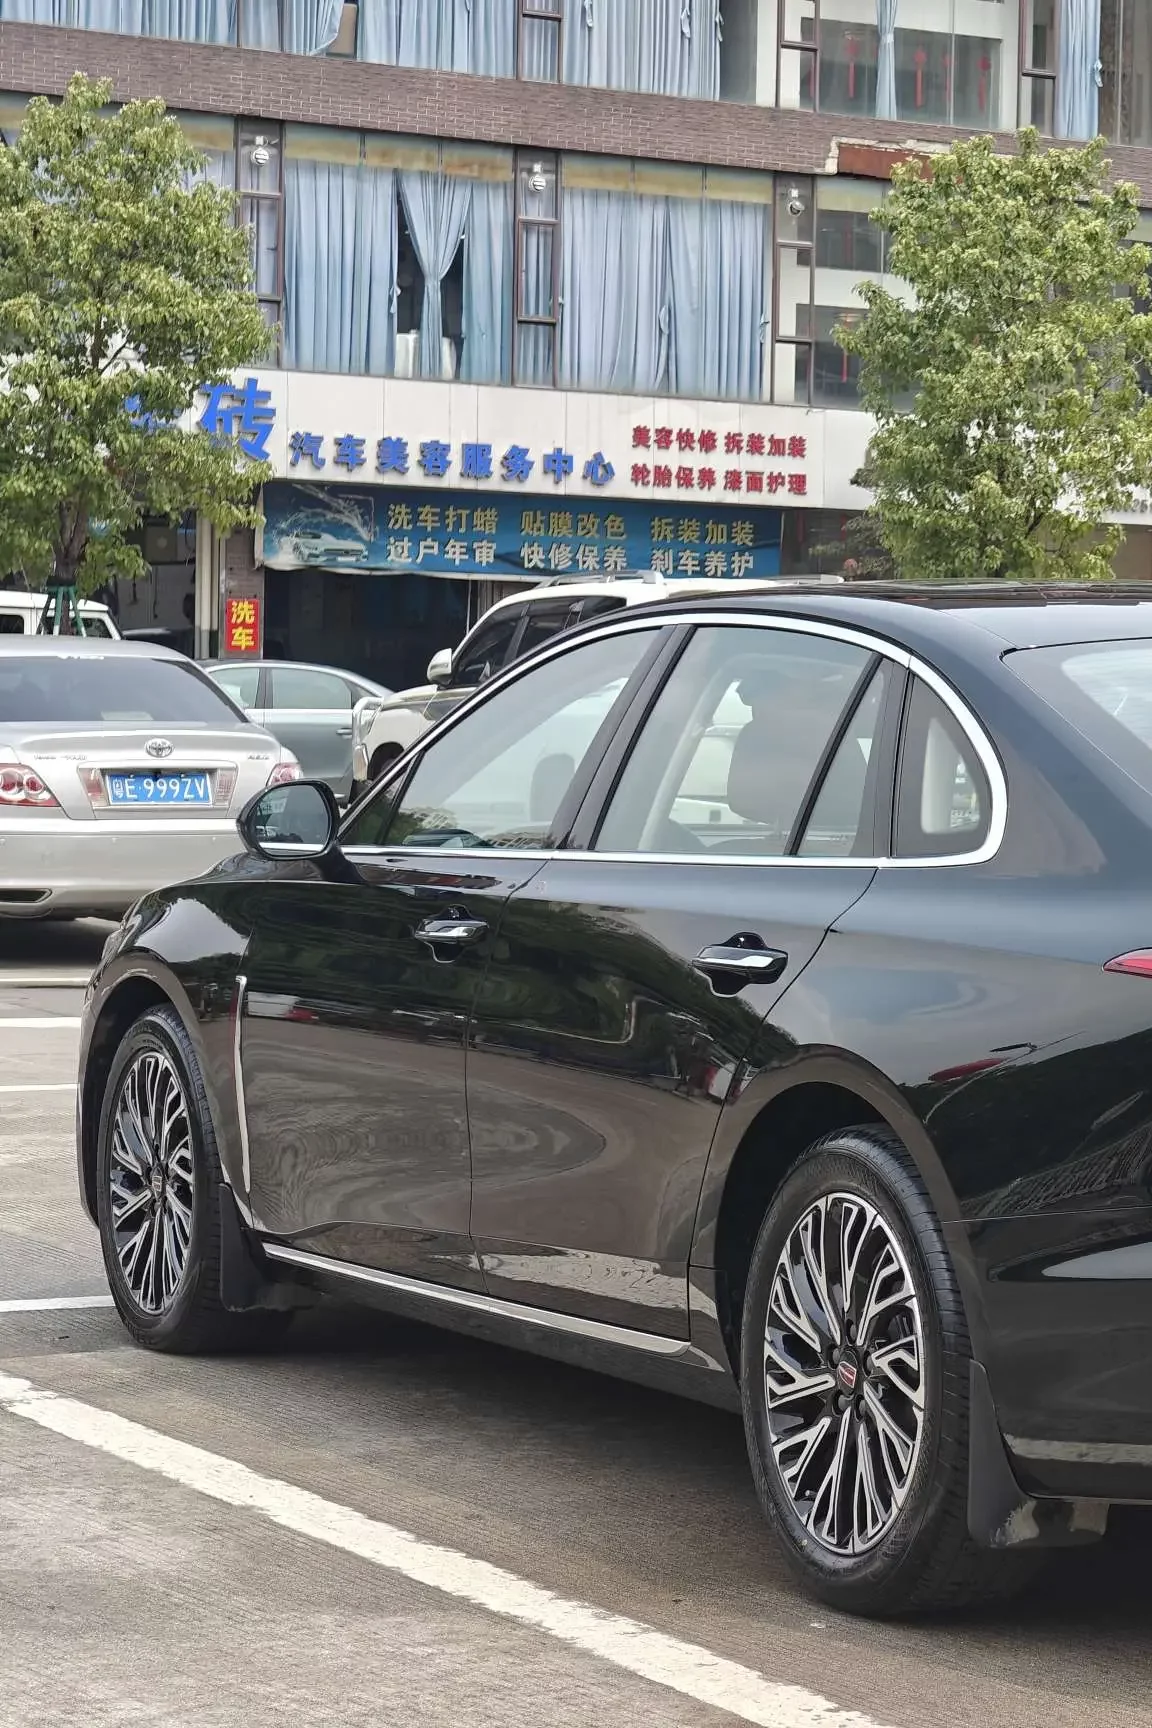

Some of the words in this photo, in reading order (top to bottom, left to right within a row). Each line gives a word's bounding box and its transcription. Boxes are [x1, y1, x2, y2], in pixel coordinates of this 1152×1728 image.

[289, 431, 615, 486] 汽车美容服务中心
[632, 425, 718, 454] 美容快修
[724, 431, 807, 458] 拆装加装
[631, 463, 716, 491] 轮胎保养
[724, 469, 807, 495] 漆面护理
[388, 503, 499, 534] 洗车打蜡
[520, 510, 627, 541] 贴膜改色
[651, 517, 755, 546] 拆装加装
[386, 536, 497, 567] 过户年审
[520, 542, 627, 571] 快修保养
[651, 550, 754, 578] 刹车养护
[231, 599, 255, 651] 洗车
